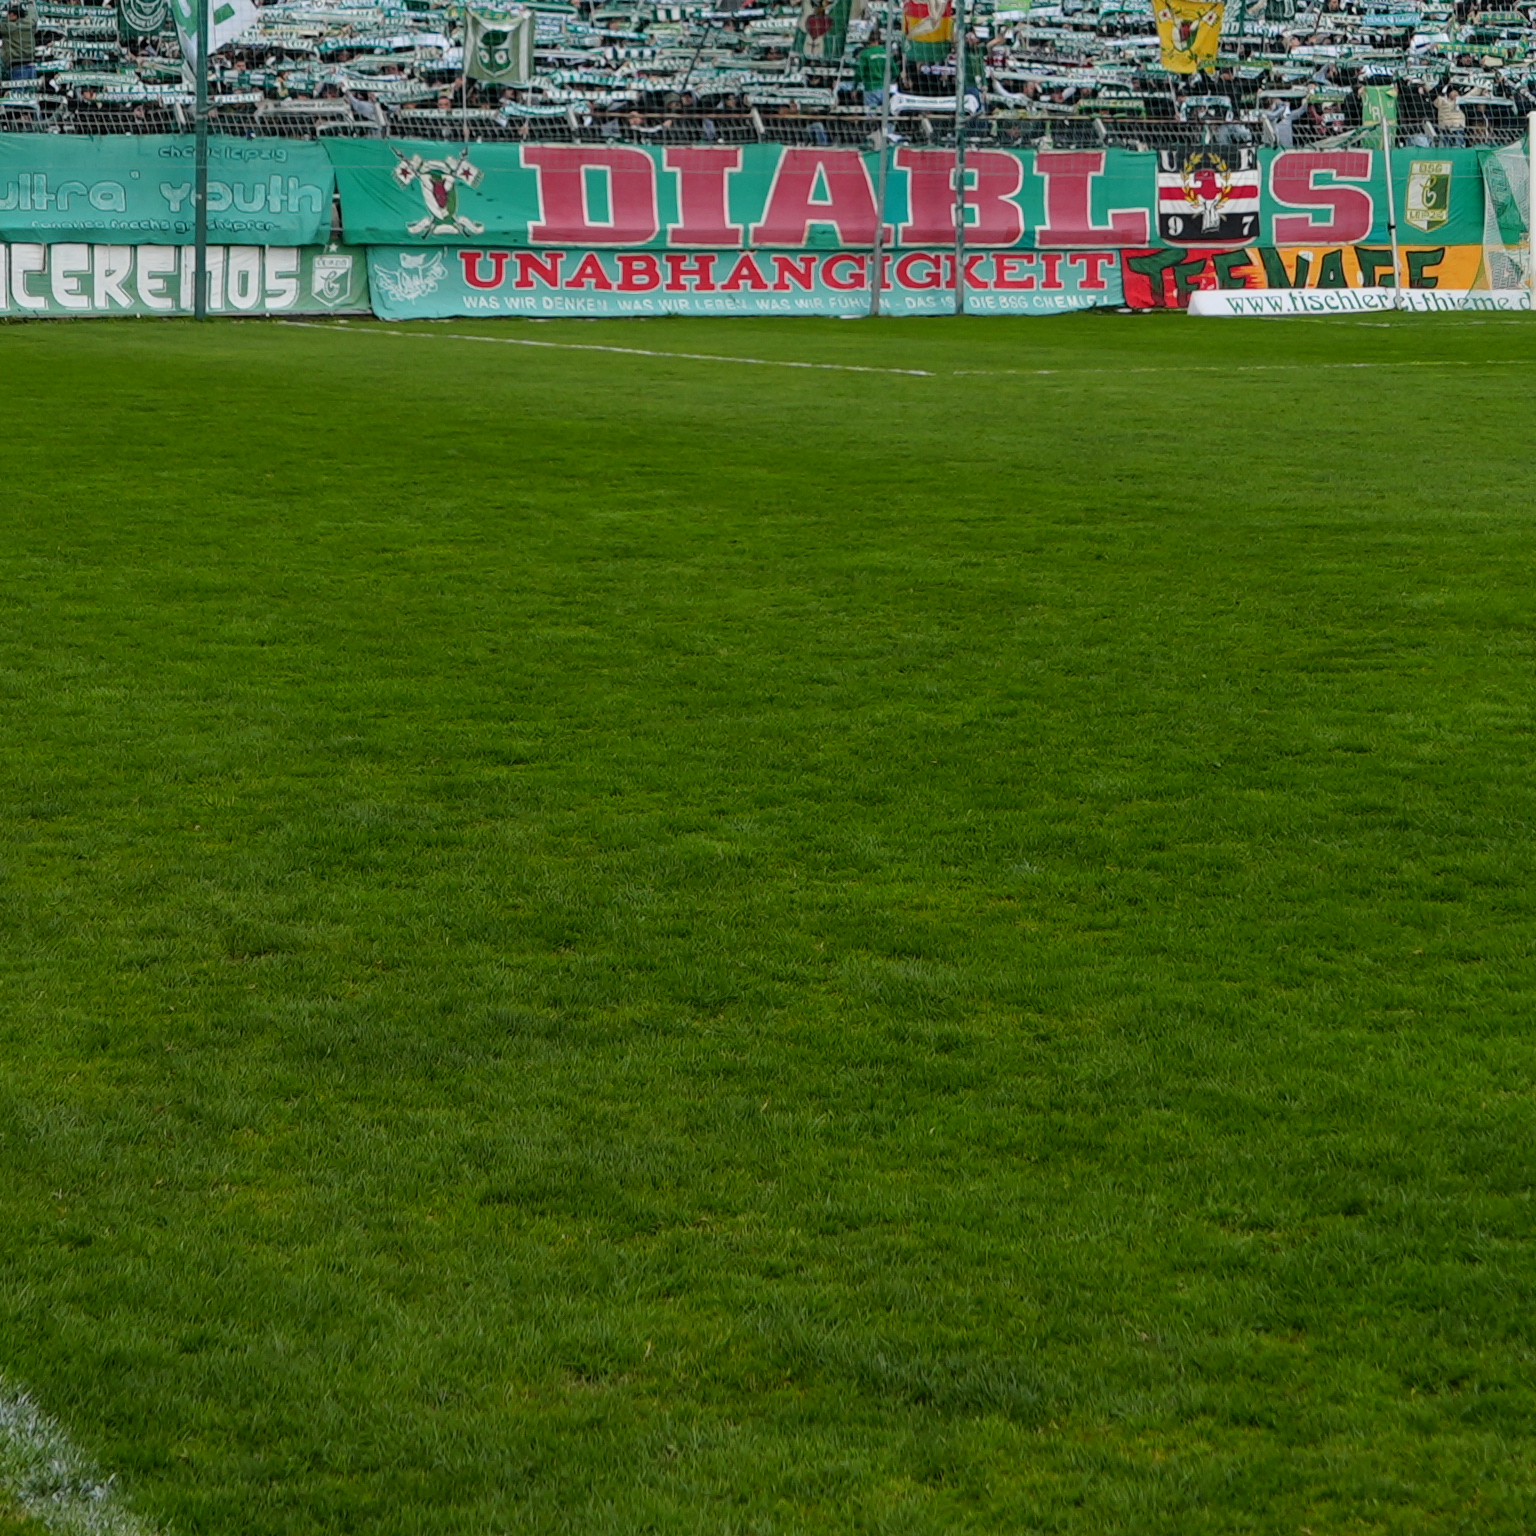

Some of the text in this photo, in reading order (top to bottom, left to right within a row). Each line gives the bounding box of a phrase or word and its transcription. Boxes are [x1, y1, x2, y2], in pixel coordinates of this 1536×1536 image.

[1160, 147, 1257, 172] U F
[158, 173, 324, 214] youth
[520, 143, 1373, 249] DIABLS
[1167, 215, 1255, 236] 9 7
[458, 249, 1116, 293] UNABHÄNGIGKEIT
[463, 295, 500, 310] WAS
[503, 296, 538, 310] WIR
[617, 298, 655, 311] WAS
[658, 299, 691, 311] WIR
[755, 297, 792, 311] WAS
[794, 297, 824, 310] WIR
[828, 294, 892, 310] FÜHLN
[906, 296, 937, 310] DAS
[941, 297, 962, 310] IS
[969, 295, 999, 310] DIE
[999, 295, 1028, 310] BSG
